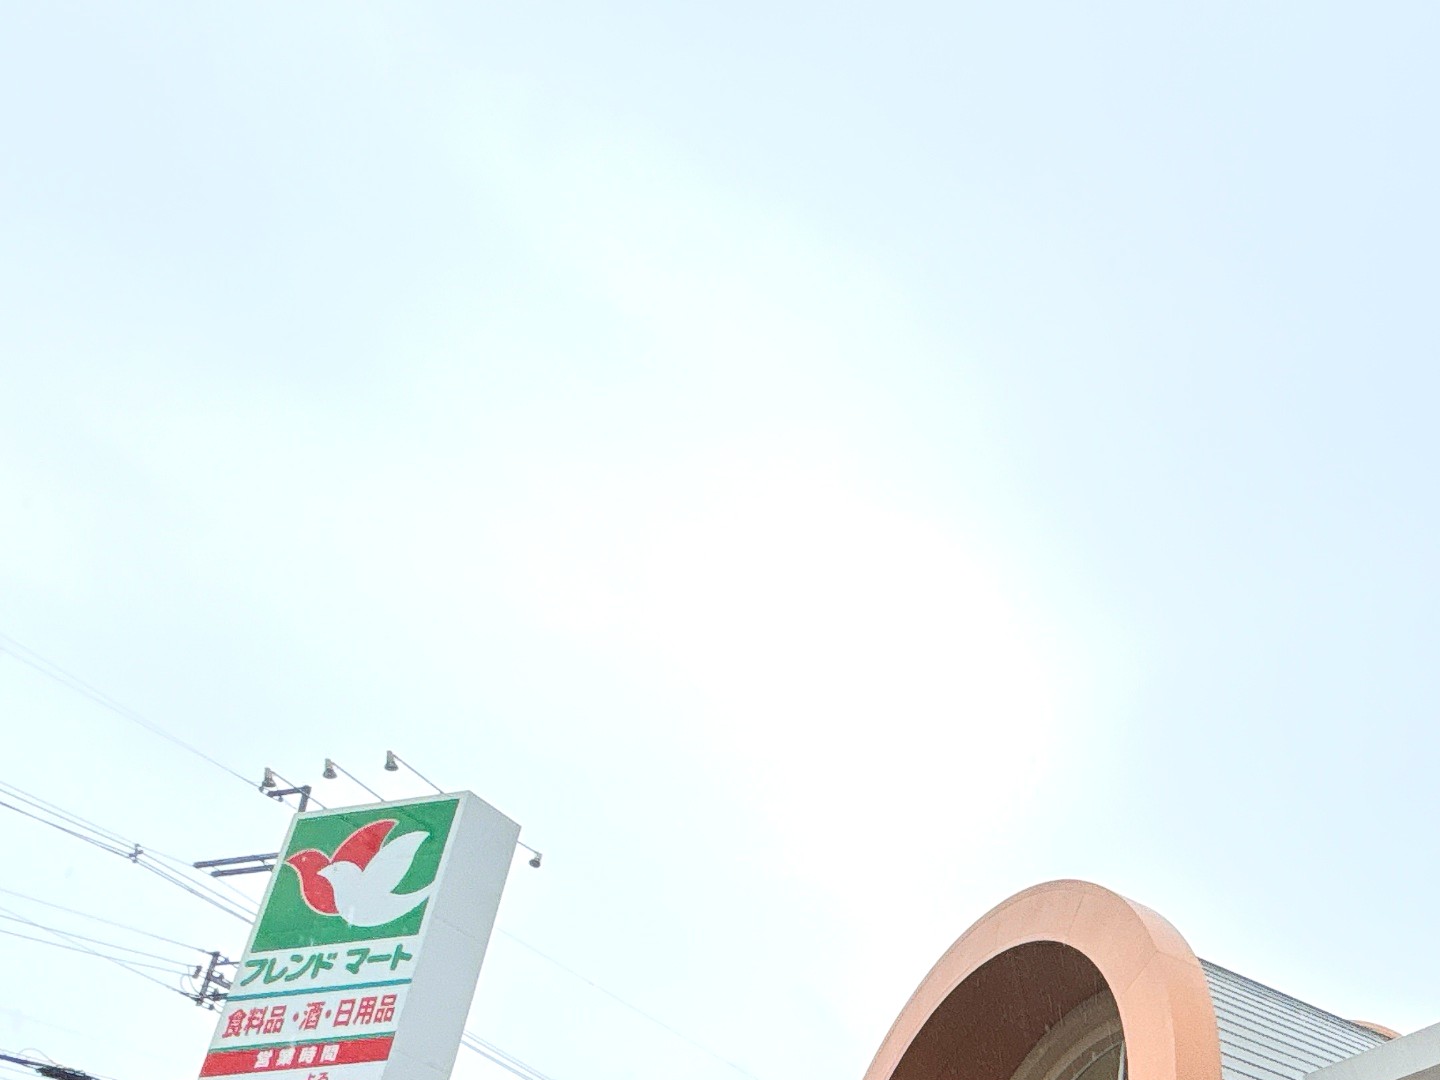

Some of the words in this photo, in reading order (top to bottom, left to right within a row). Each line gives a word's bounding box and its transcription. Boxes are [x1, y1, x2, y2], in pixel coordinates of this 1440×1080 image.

[240, 944, 413, 987] フレンドマート
[222, 994, 398, 1038] 食料品・酒・日用品
[254, 1044, 340, 1069] 営業時間
